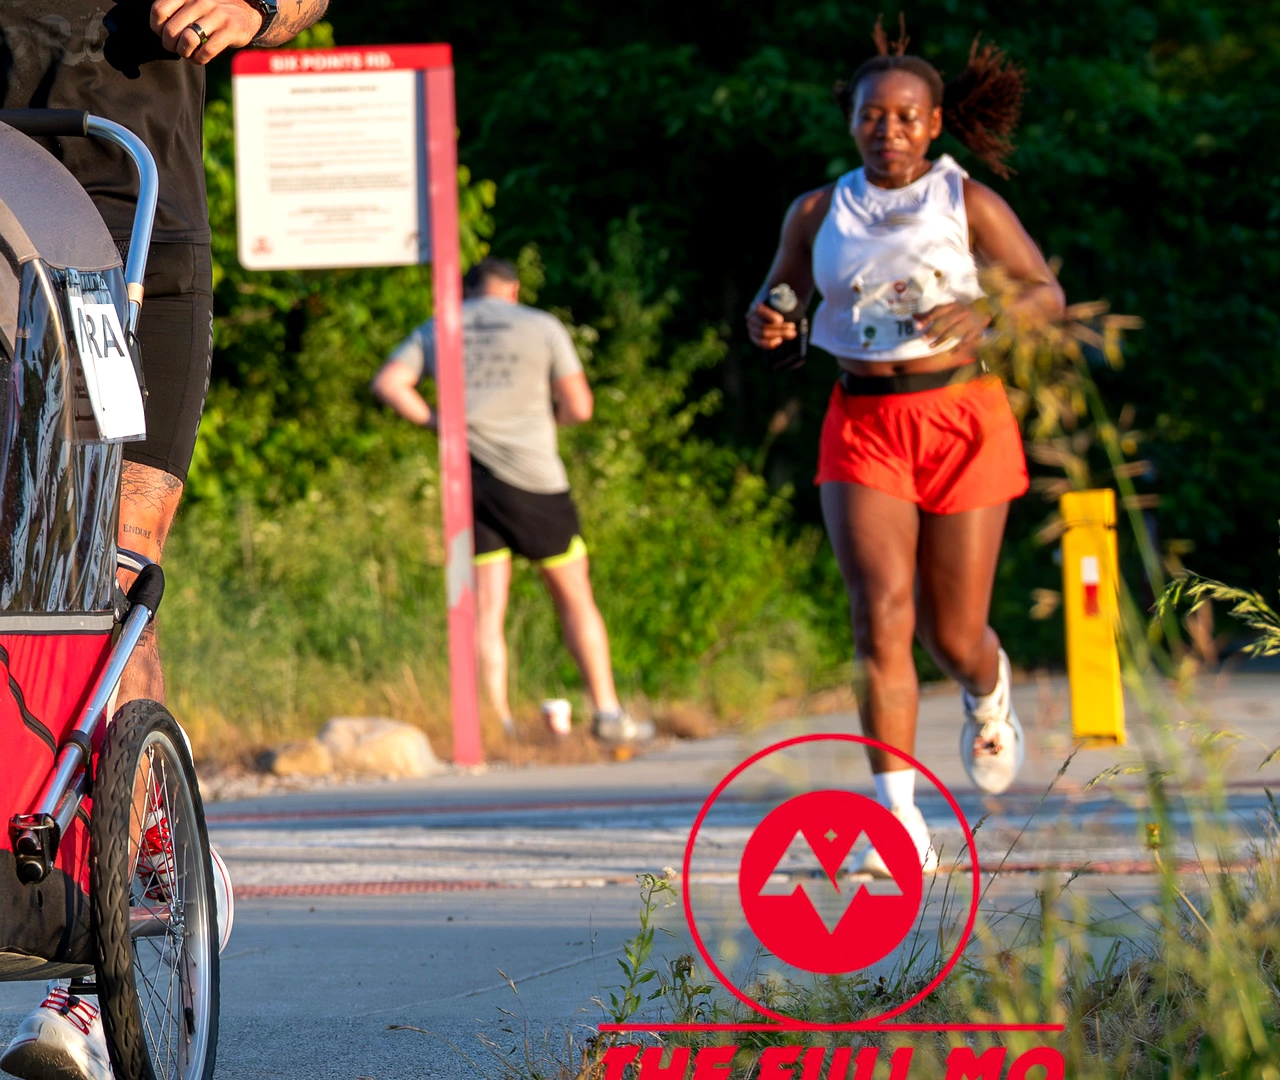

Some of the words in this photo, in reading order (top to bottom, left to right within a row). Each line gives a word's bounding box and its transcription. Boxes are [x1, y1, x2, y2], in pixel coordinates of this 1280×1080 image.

[270, 55, 298, 73] SIX
[301, 52, 363, 71] POINTS
[364, 51, 395, 69] RD.
